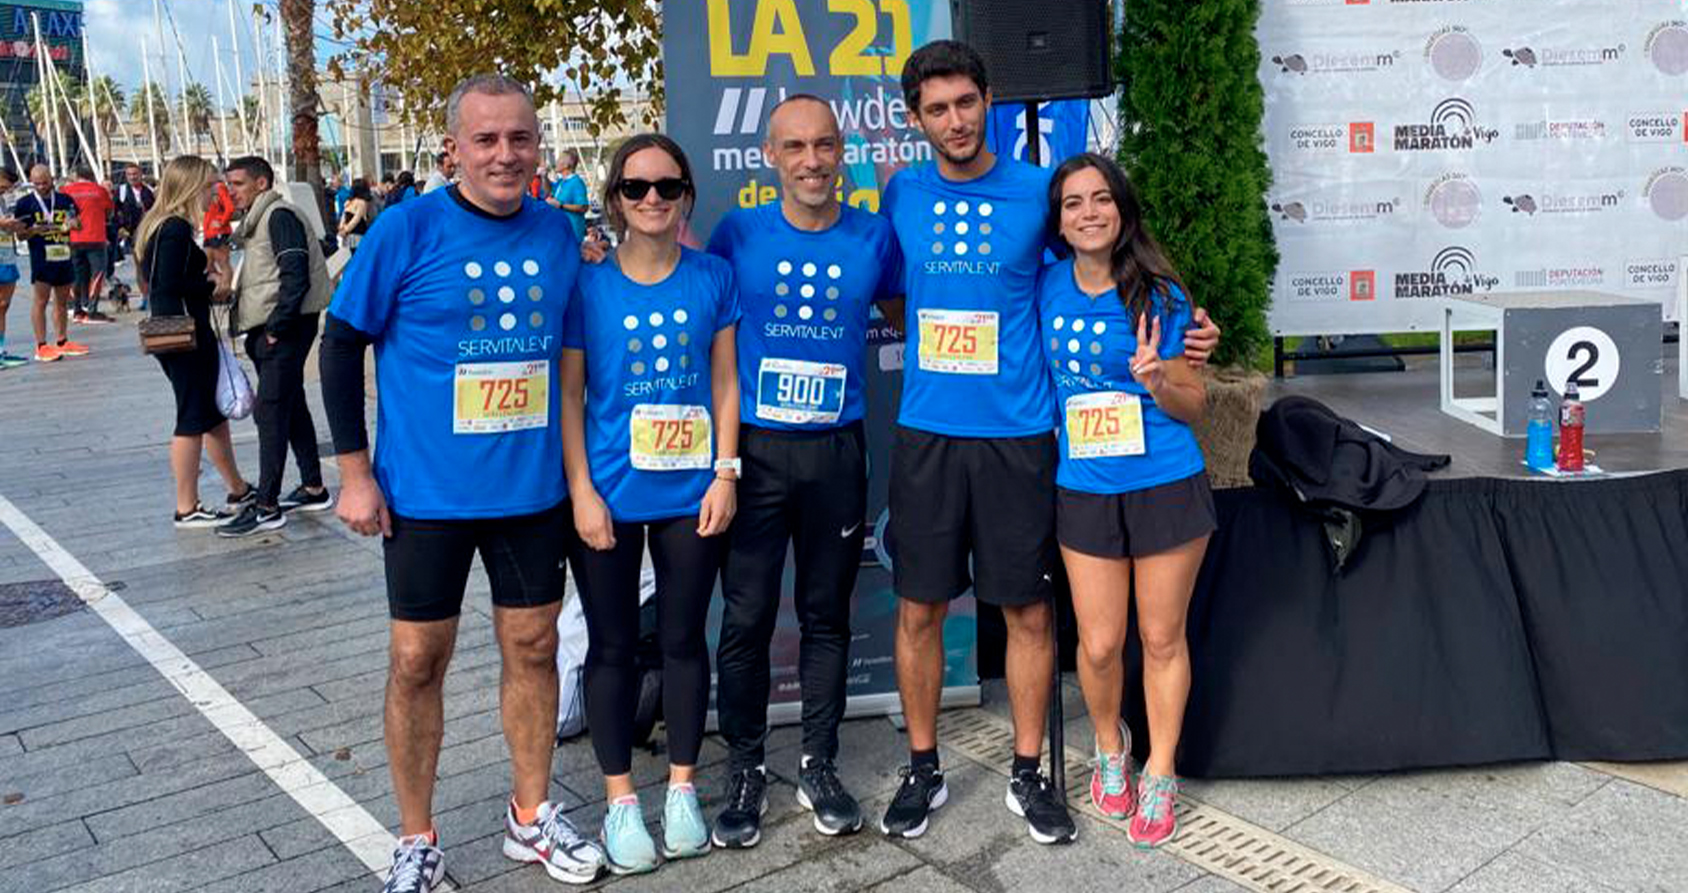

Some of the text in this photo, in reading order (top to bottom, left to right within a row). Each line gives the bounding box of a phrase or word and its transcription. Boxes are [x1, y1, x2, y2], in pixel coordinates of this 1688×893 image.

[707, 0, 815, 76] LA
[1395, 124, 1445, 137] MEDIA
[1629, 119, 1677, 128] CONCELLO
[1290, 130, 1343, 139] CONCELLO
[1473, 126, 1499, 142] Vigo
[1635, 128, 1673, 137] DE VIGO
[841, 135, 932, 165] aratón
[1298, 140, 1336, 149] DE VIGO
[1395, 134, 1473, 150] MARATÓN
[1628, 265, 1675, 274] CONCELLO
[1292, 277, 1343, 287] CONCELLO
[1395, 272, 1446, 285] MEDIA
[1473, 274, 1499, 291] Vigo
[1649, 274, 1669, 282] VIGO
[1298, 287, 1337, 296] DE VIGO
[1395, 281, 1473, 298] MARATÓN
[934, 325, 977, 353] 725
[1566, 341, 1599, 387] 2
[480, 378, 528, 411] 725
[777, 374, 826, 405] 900
[1079, 407, 1121, 437] 725
[651, 420, 694, 450] 725
